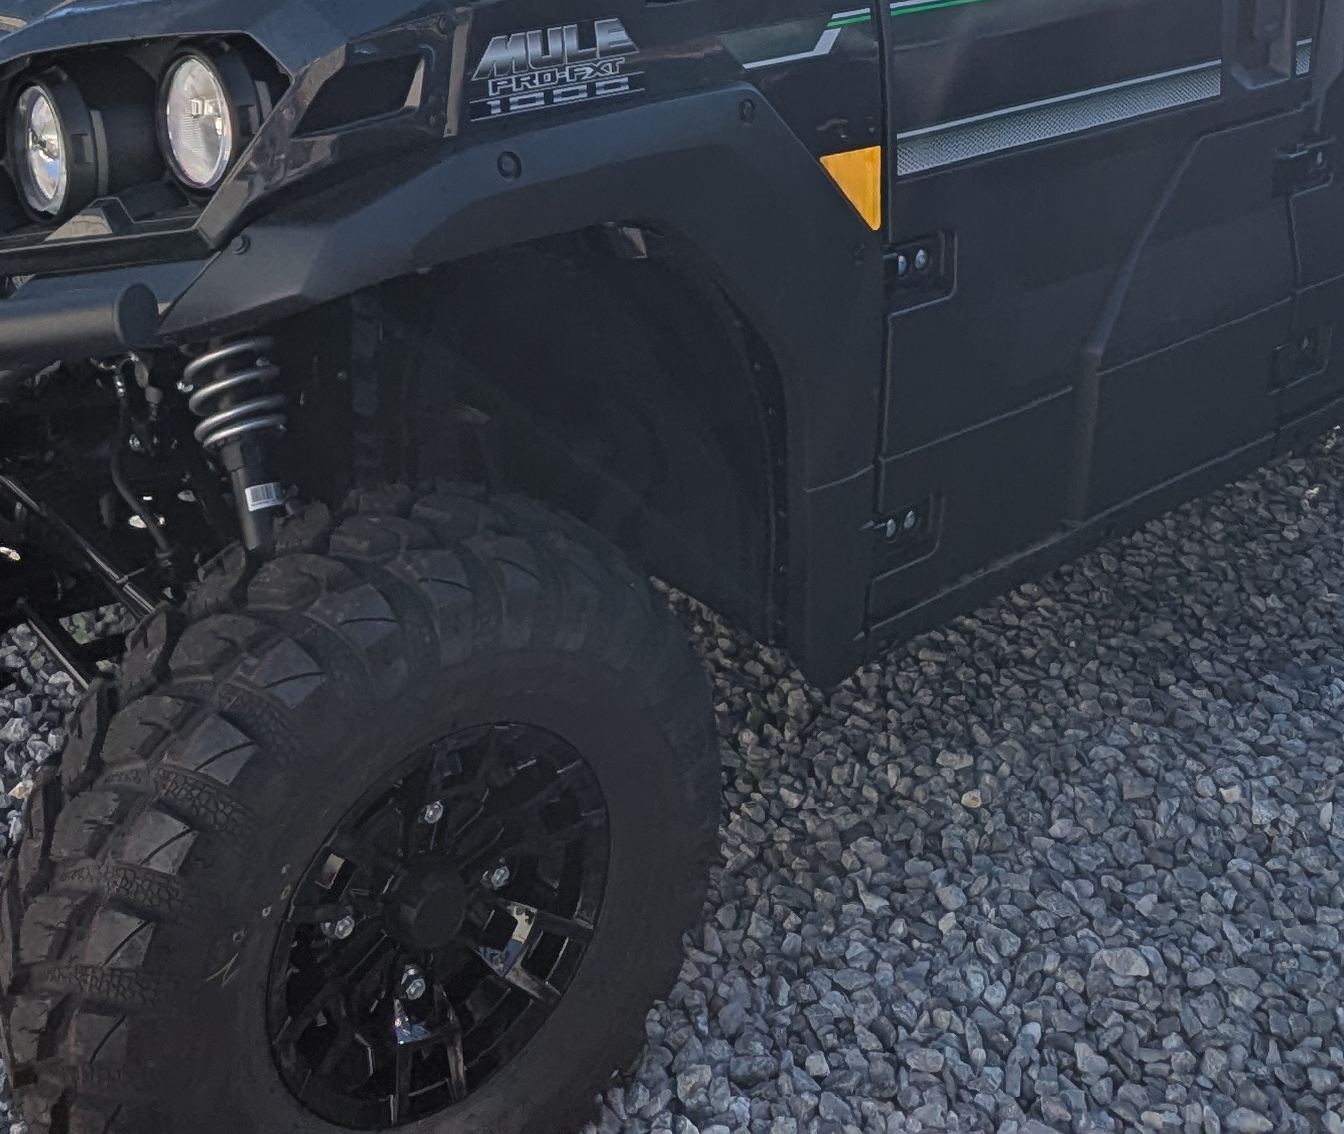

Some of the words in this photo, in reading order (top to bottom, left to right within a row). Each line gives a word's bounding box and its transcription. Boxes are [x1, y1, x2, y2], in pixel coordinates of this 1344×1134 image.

[471, 17, 640, 82] MULE
[486, 76, 630, 115] 1000
[488, 57, 626, 97] PRO-FXT
